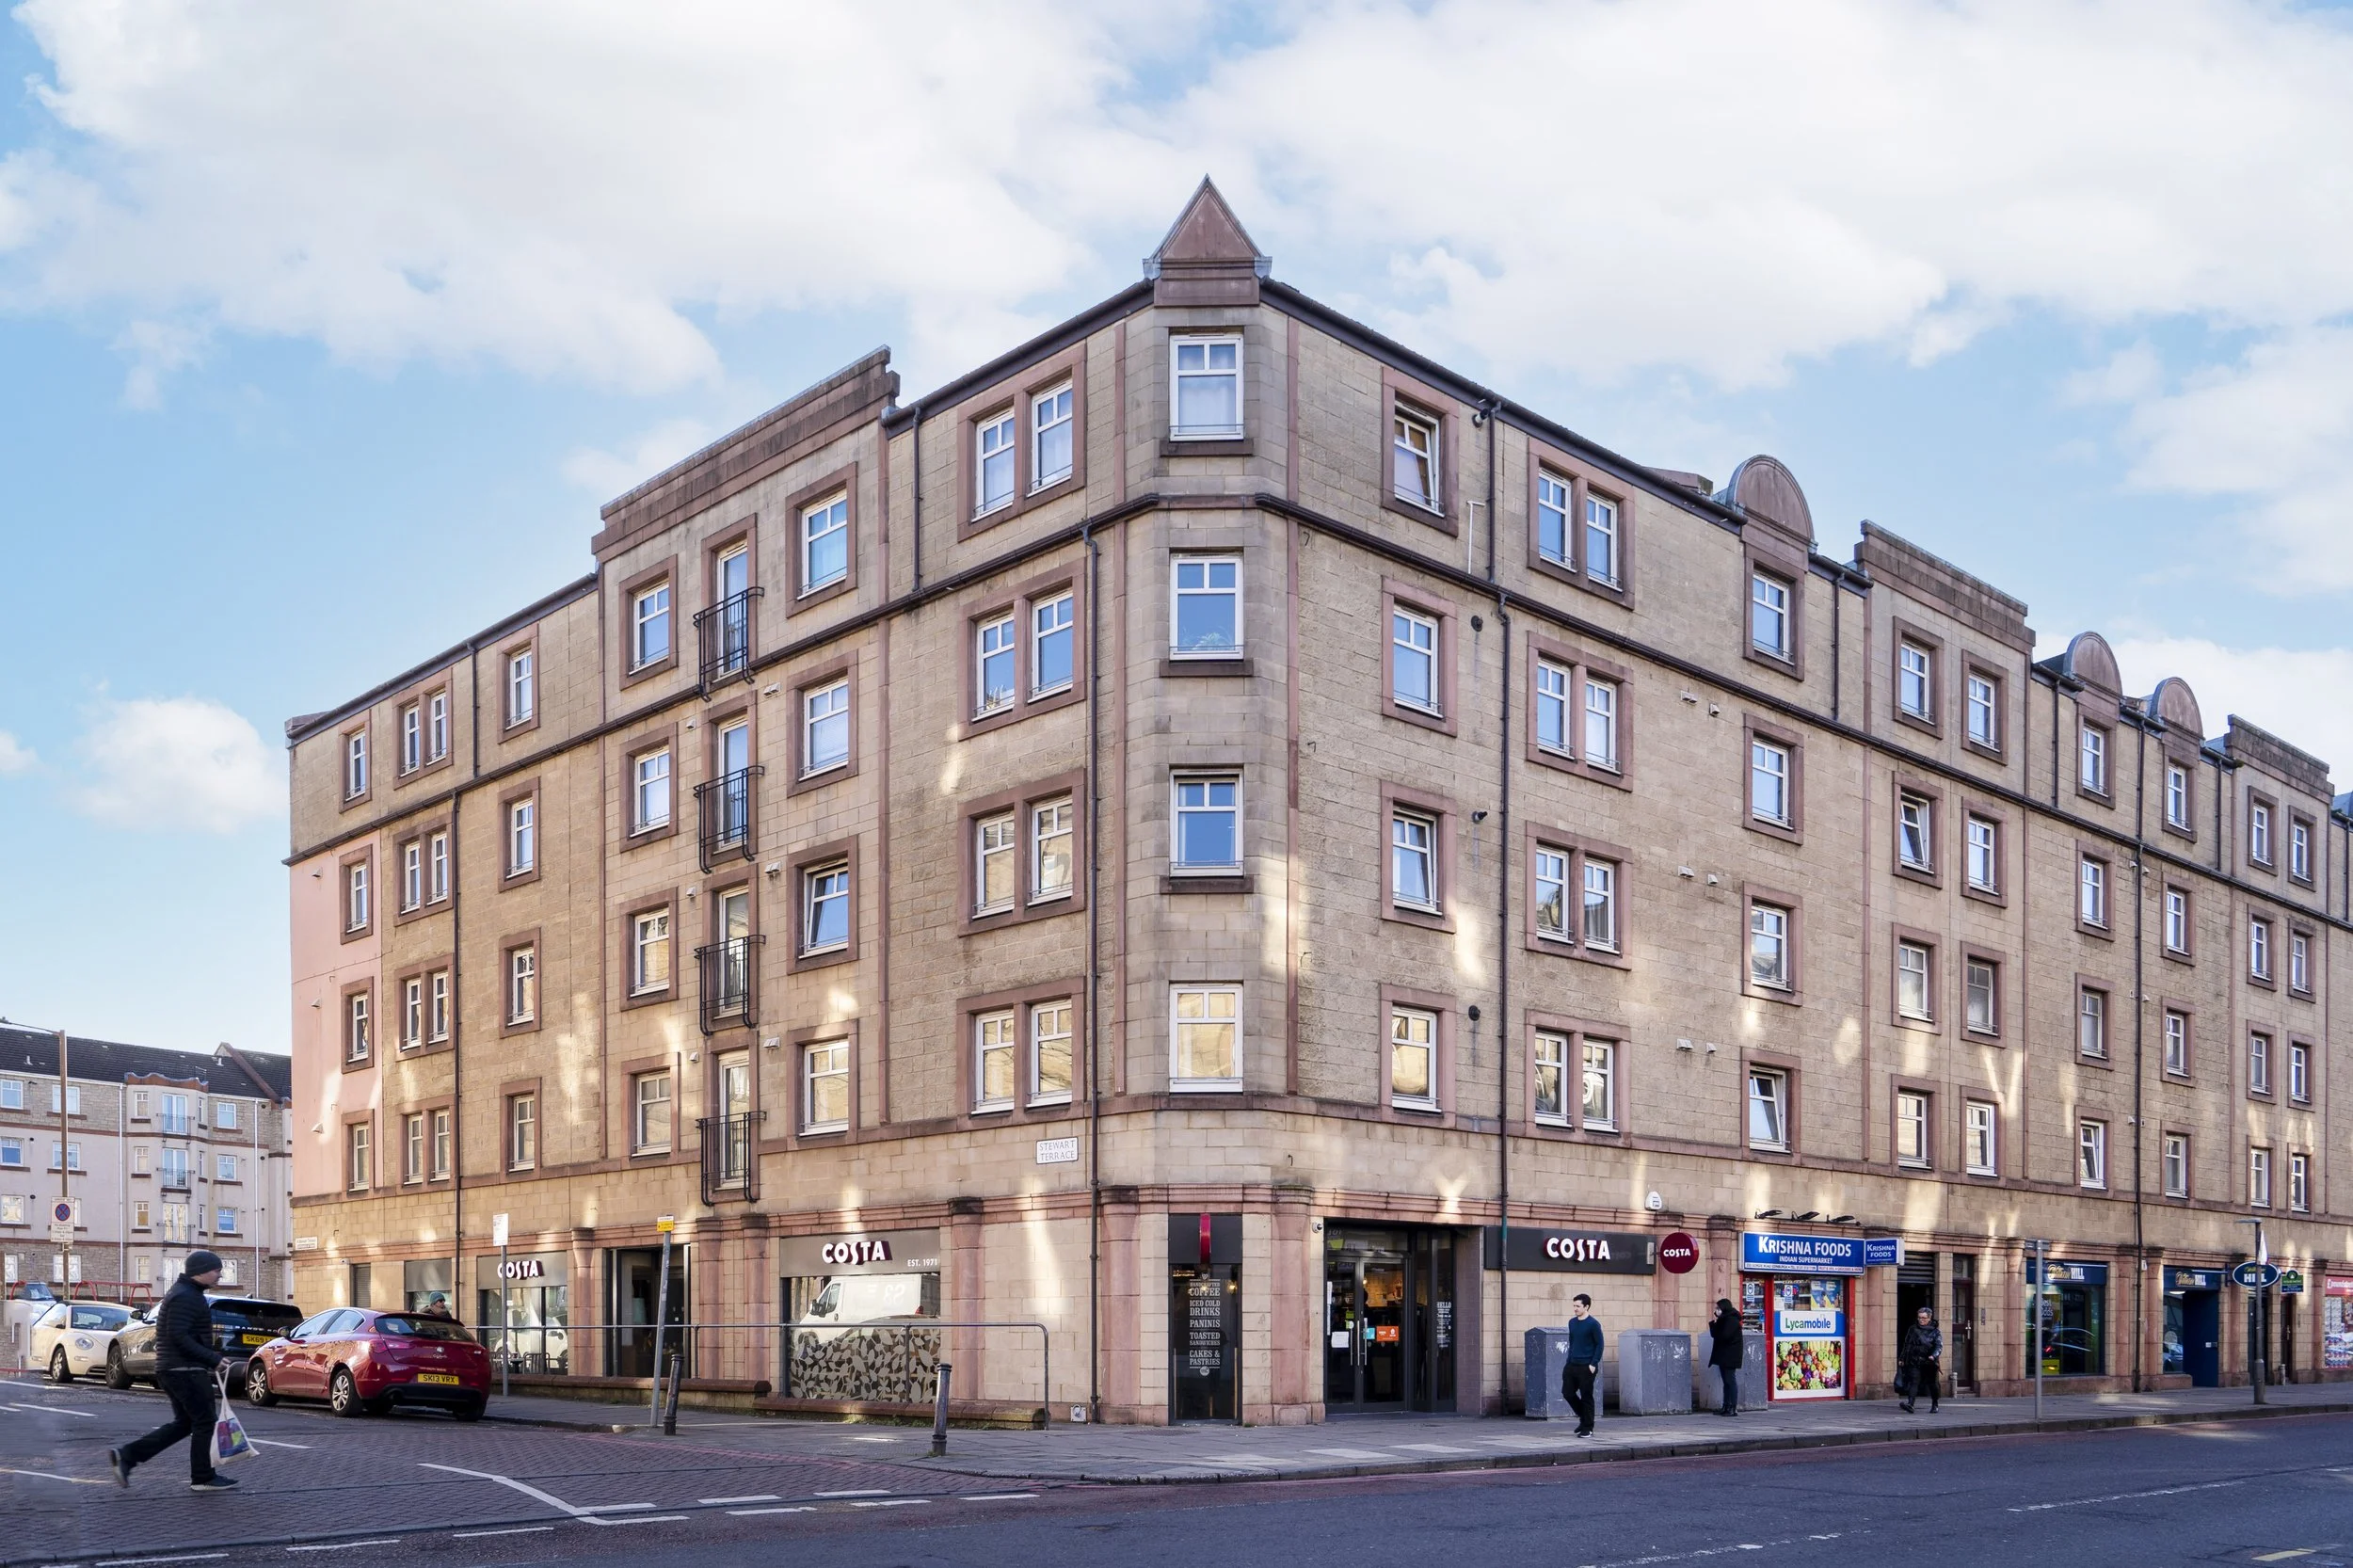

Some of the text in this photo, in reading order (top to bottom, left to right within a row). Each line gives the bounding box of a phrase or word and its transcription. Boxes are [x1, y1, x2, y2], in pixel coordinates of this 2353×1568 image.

[1039, 1140, 1076, 1151] STEWART
[1040, 1151, 1075, 1161] TERRACE
[1545, 1237, 1611, 1262] COSTA
[1758, 1236, 1851, 1257] KRISHNA FOODS
[822, 1240, 888, 1266] COSTA
[1662, 1248, 1691, 1258] COSTA
[922, 1258, 938, 1267] 1971
[497, 1259, 540, 1280] COSTA
[2071, 1267, 2085, 1280] HILL
[2194, 1274, 2206, 1286] HILL
[2244, 1273, 2266, 1283] HIL
[1190, 1288, 1220, 1297] COFFEE
[1190, 1307, 1220, 1316] DRINKS
[1190, 1320, 1220, 1328] PANINIS
[1785, 1317, 1831, 1331] Lycamobile
